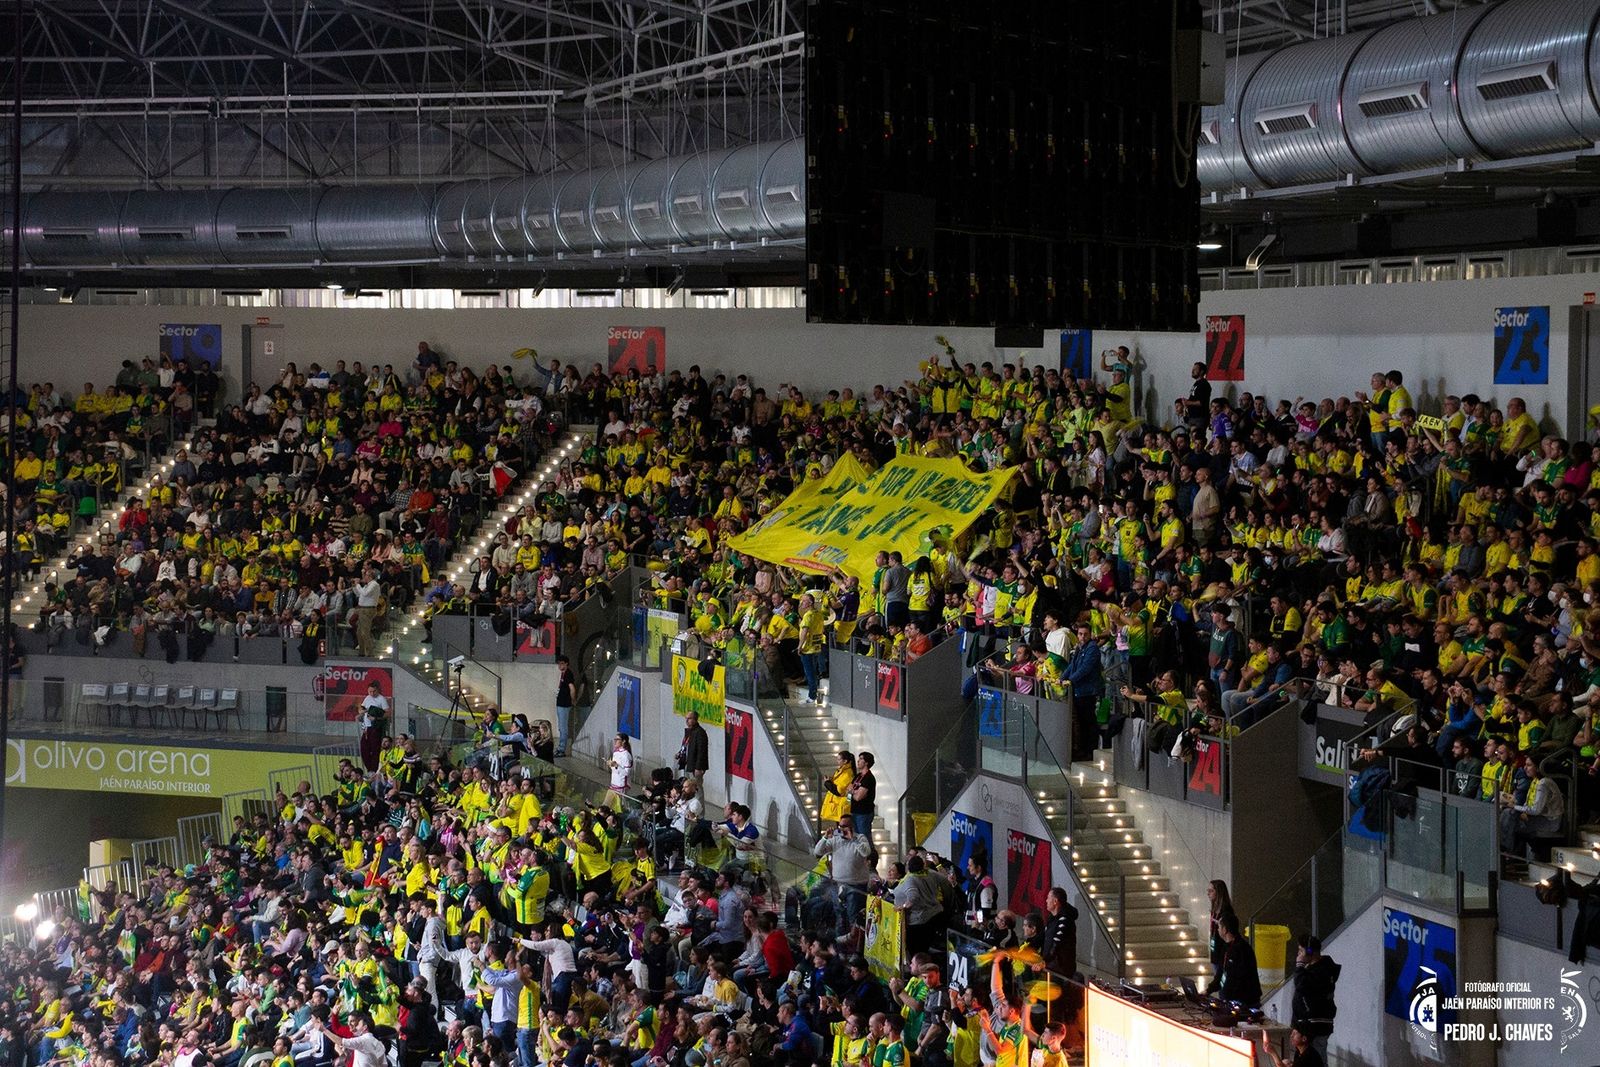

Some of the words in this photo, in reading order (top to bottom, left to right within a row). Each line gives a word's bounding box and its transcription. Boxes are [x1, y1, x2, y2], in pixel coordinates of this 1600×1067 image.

[159, 325, 199, 336] Sector
[1206, 317, 1231, 332] Sector
[1494, 308, 1530, 327] Sector
[608, 327, 645, 339] Sector
[1494, 307, 1549, 384] 23
[608, 327, 665, 376] 20
[1206, 316, 1245, 381] 22
[325, 666, 369, 681] Sector
[617, 673, 633, 691] Sector
[878, 662, 893, 676] Sector
[878, 665, 899, 710] 22
[725, 706, 743, 727] Sector
[34, 740, 105, 770] olivo
[117, 749, 210, 776] arena
[100, 775, 122, 788] JAÉN
[124, 777, 164, 791] PARAÍSO
[167, 781, 211, 793] INTERIOR
[950, 810, 978, 838] Sector
[1007, 828, 1036, 857] Sector
[1007, 828, 1052, 925] 24
[1383, 908, 1429, 946] Sector
[948, 951, 969, 989] 24
